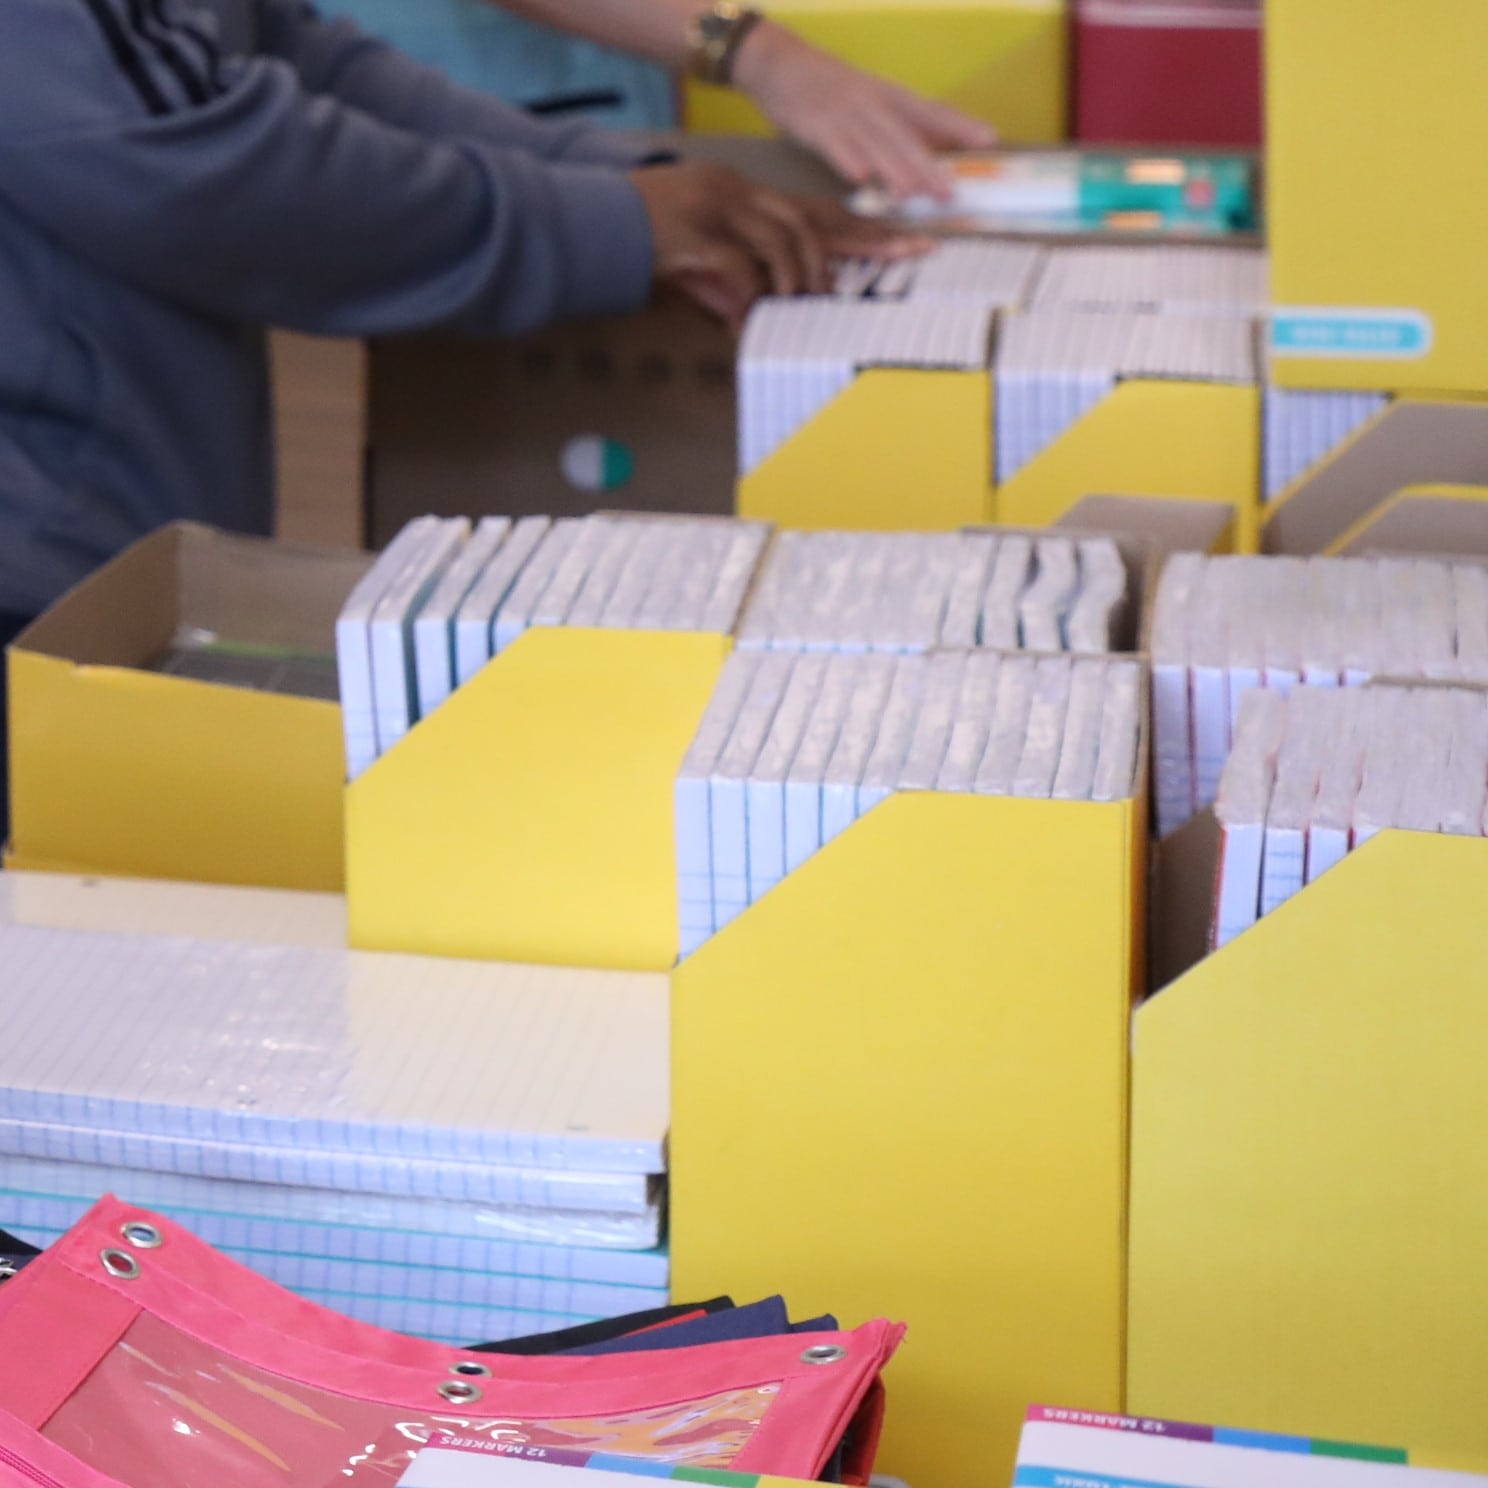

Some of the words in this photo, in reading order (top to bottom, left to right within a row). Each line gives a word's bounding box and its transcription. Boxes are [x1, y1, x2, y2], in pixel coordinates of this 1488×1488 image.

[1043, 1408, 1138, 1429] MARKERS
[1141, 1421, 1166, 1432] 12
[440, 1436, 523, 1454] MARKERS
[526, 1446, 547, 1457] 12
